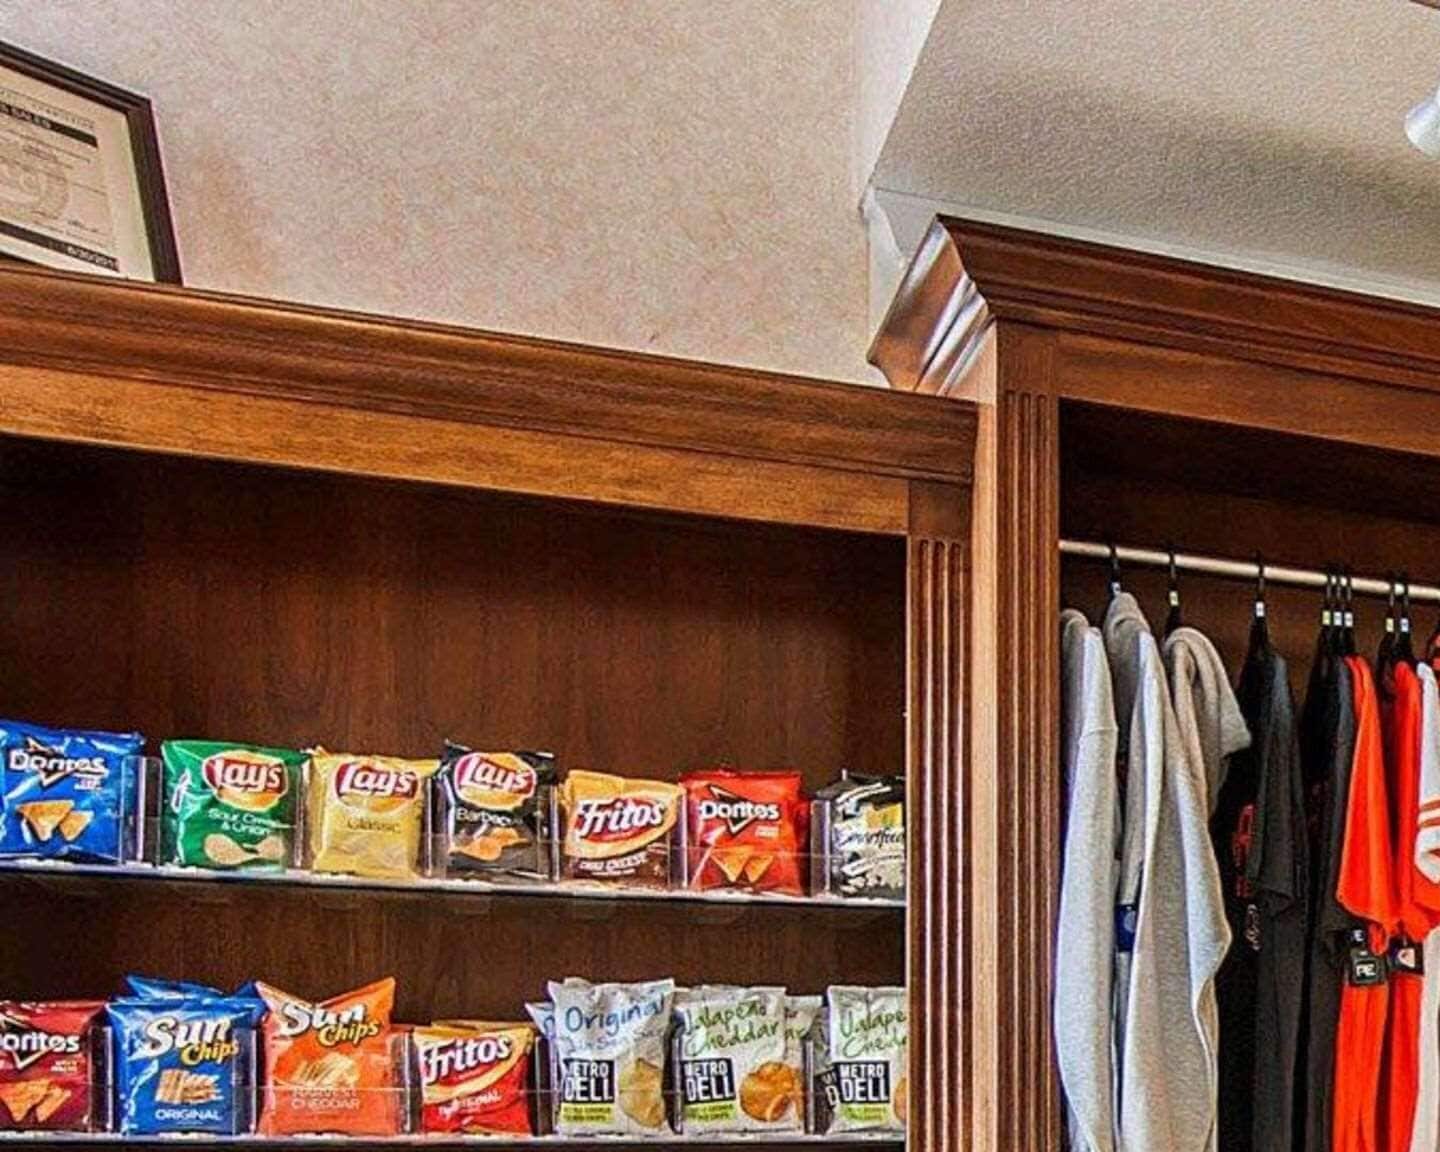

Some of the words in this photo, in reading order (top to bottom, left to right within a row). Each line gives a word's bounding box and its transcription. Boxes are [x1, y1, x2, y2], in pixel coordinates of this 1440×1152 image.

[575, 799, 664, 837] Fritos
[701, 801, 779, 820] Doritos
[281, 1002, 365, 1036] Sun
[0, 1031, 81, 1053] oritos
[140, 1016, 231, 1058] Sun
[320, 1021, 379, 1047] Chips
[420, 1036, 513, 1086] Fritos
[839, 1064, 884, 1079] METRO
[155, 1109, 223, 1121] ORIGINAL
